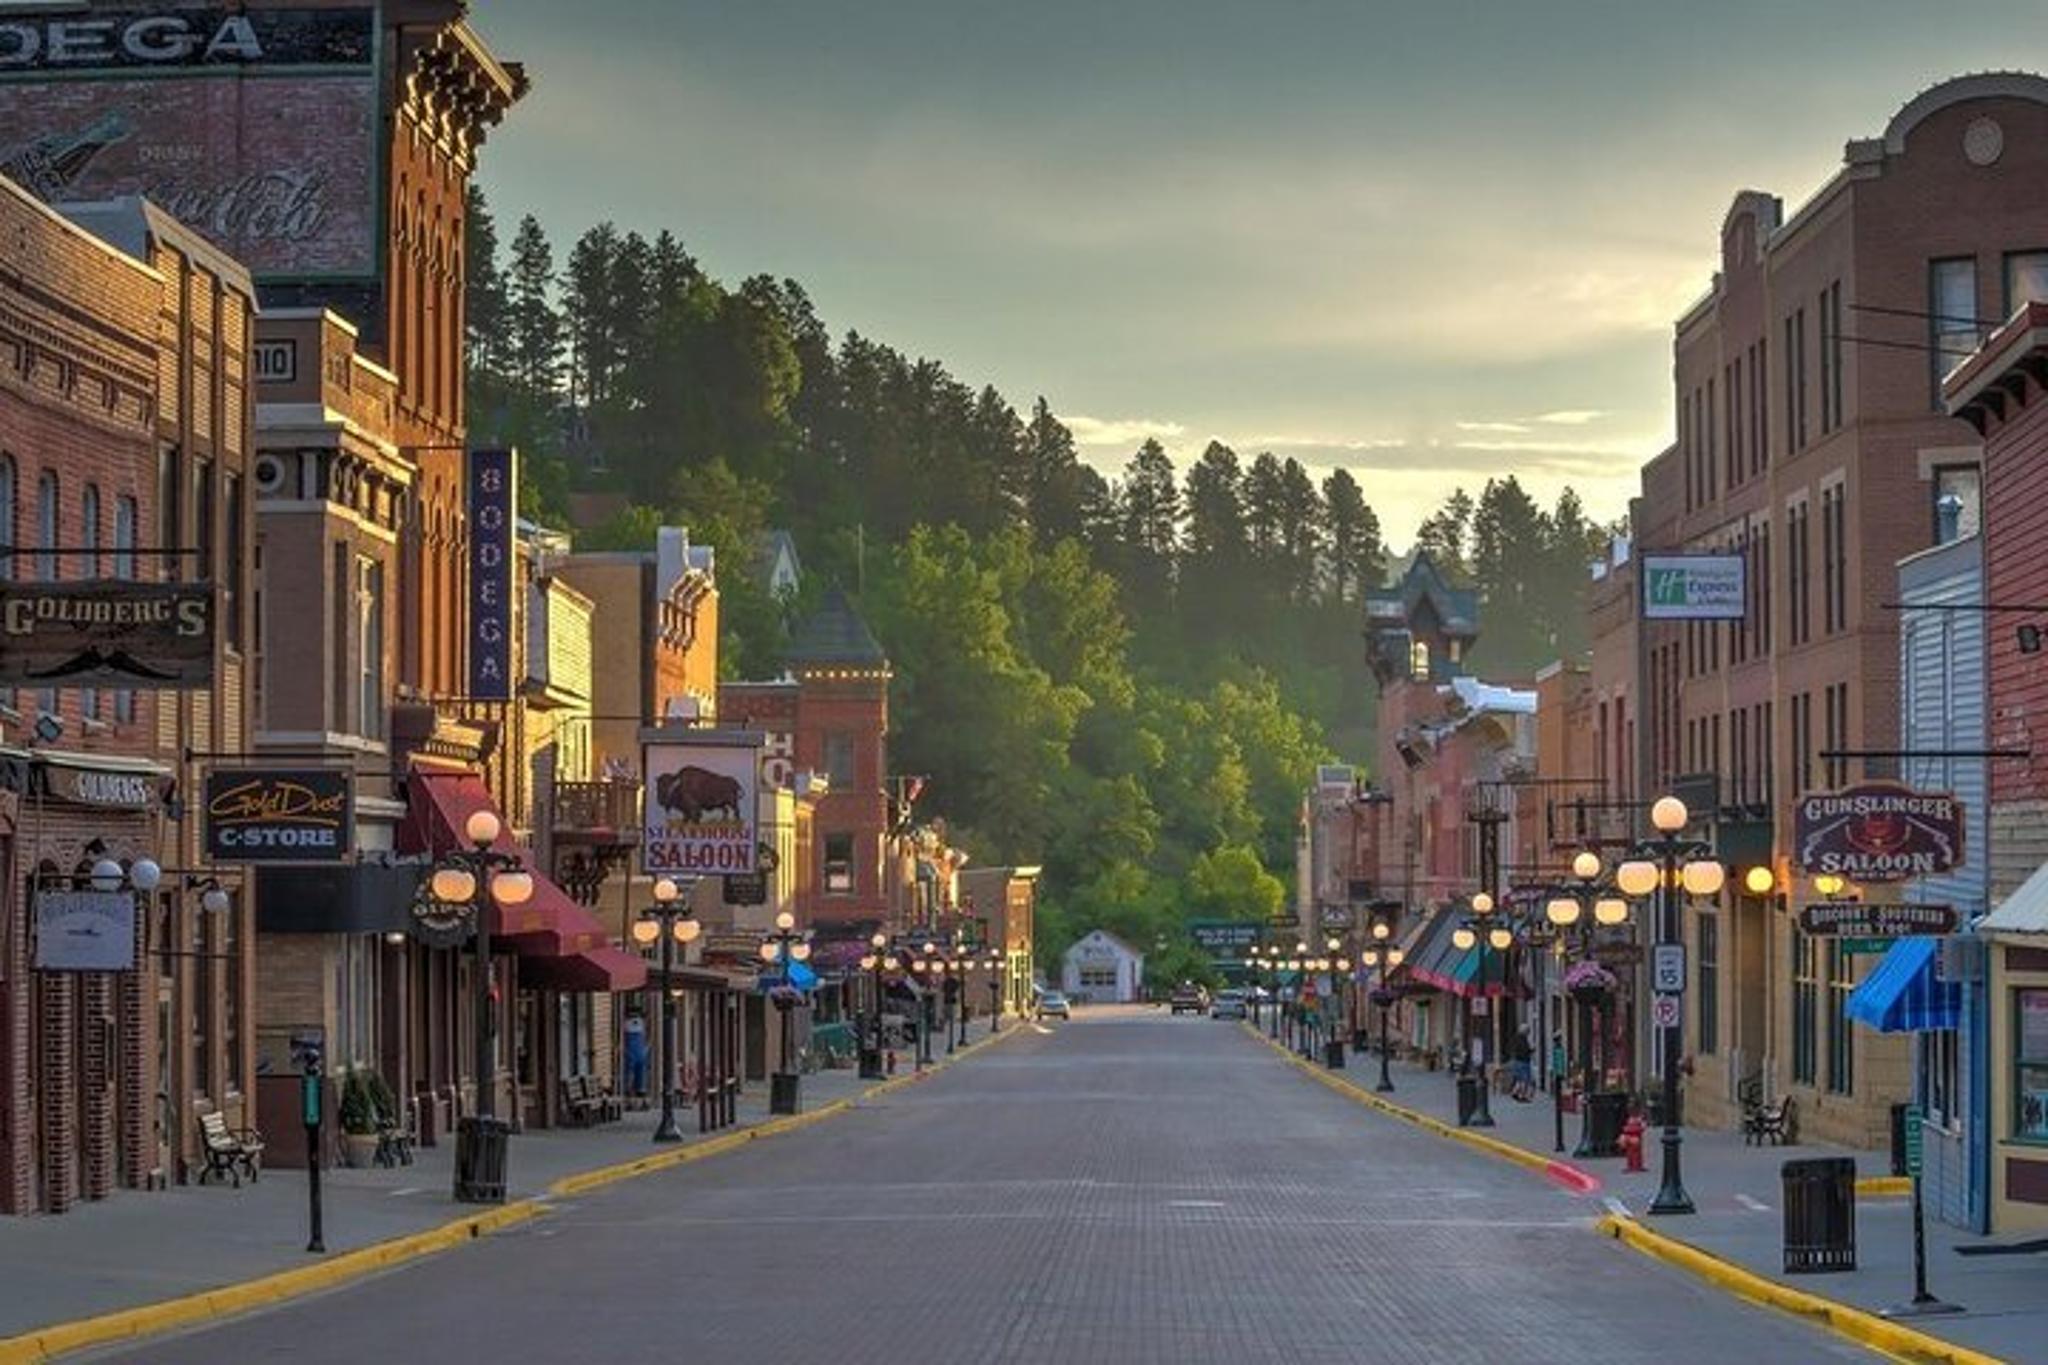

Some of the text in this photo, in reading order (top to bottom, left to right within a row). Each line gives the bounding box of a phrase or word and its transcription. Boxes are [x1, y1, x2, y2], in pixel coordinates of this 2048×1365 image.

[479, 467, 502, 679] BODEGA
[5, 593, 207, 636] GOLDBERG'S
[210, 780, 345, 816] Gold Dust
[1804, 796, 1953, 821] GUNSLINGER
[649, 840, 753, 869] SALOON
[1819, 851, 1936, 874] SALOON
